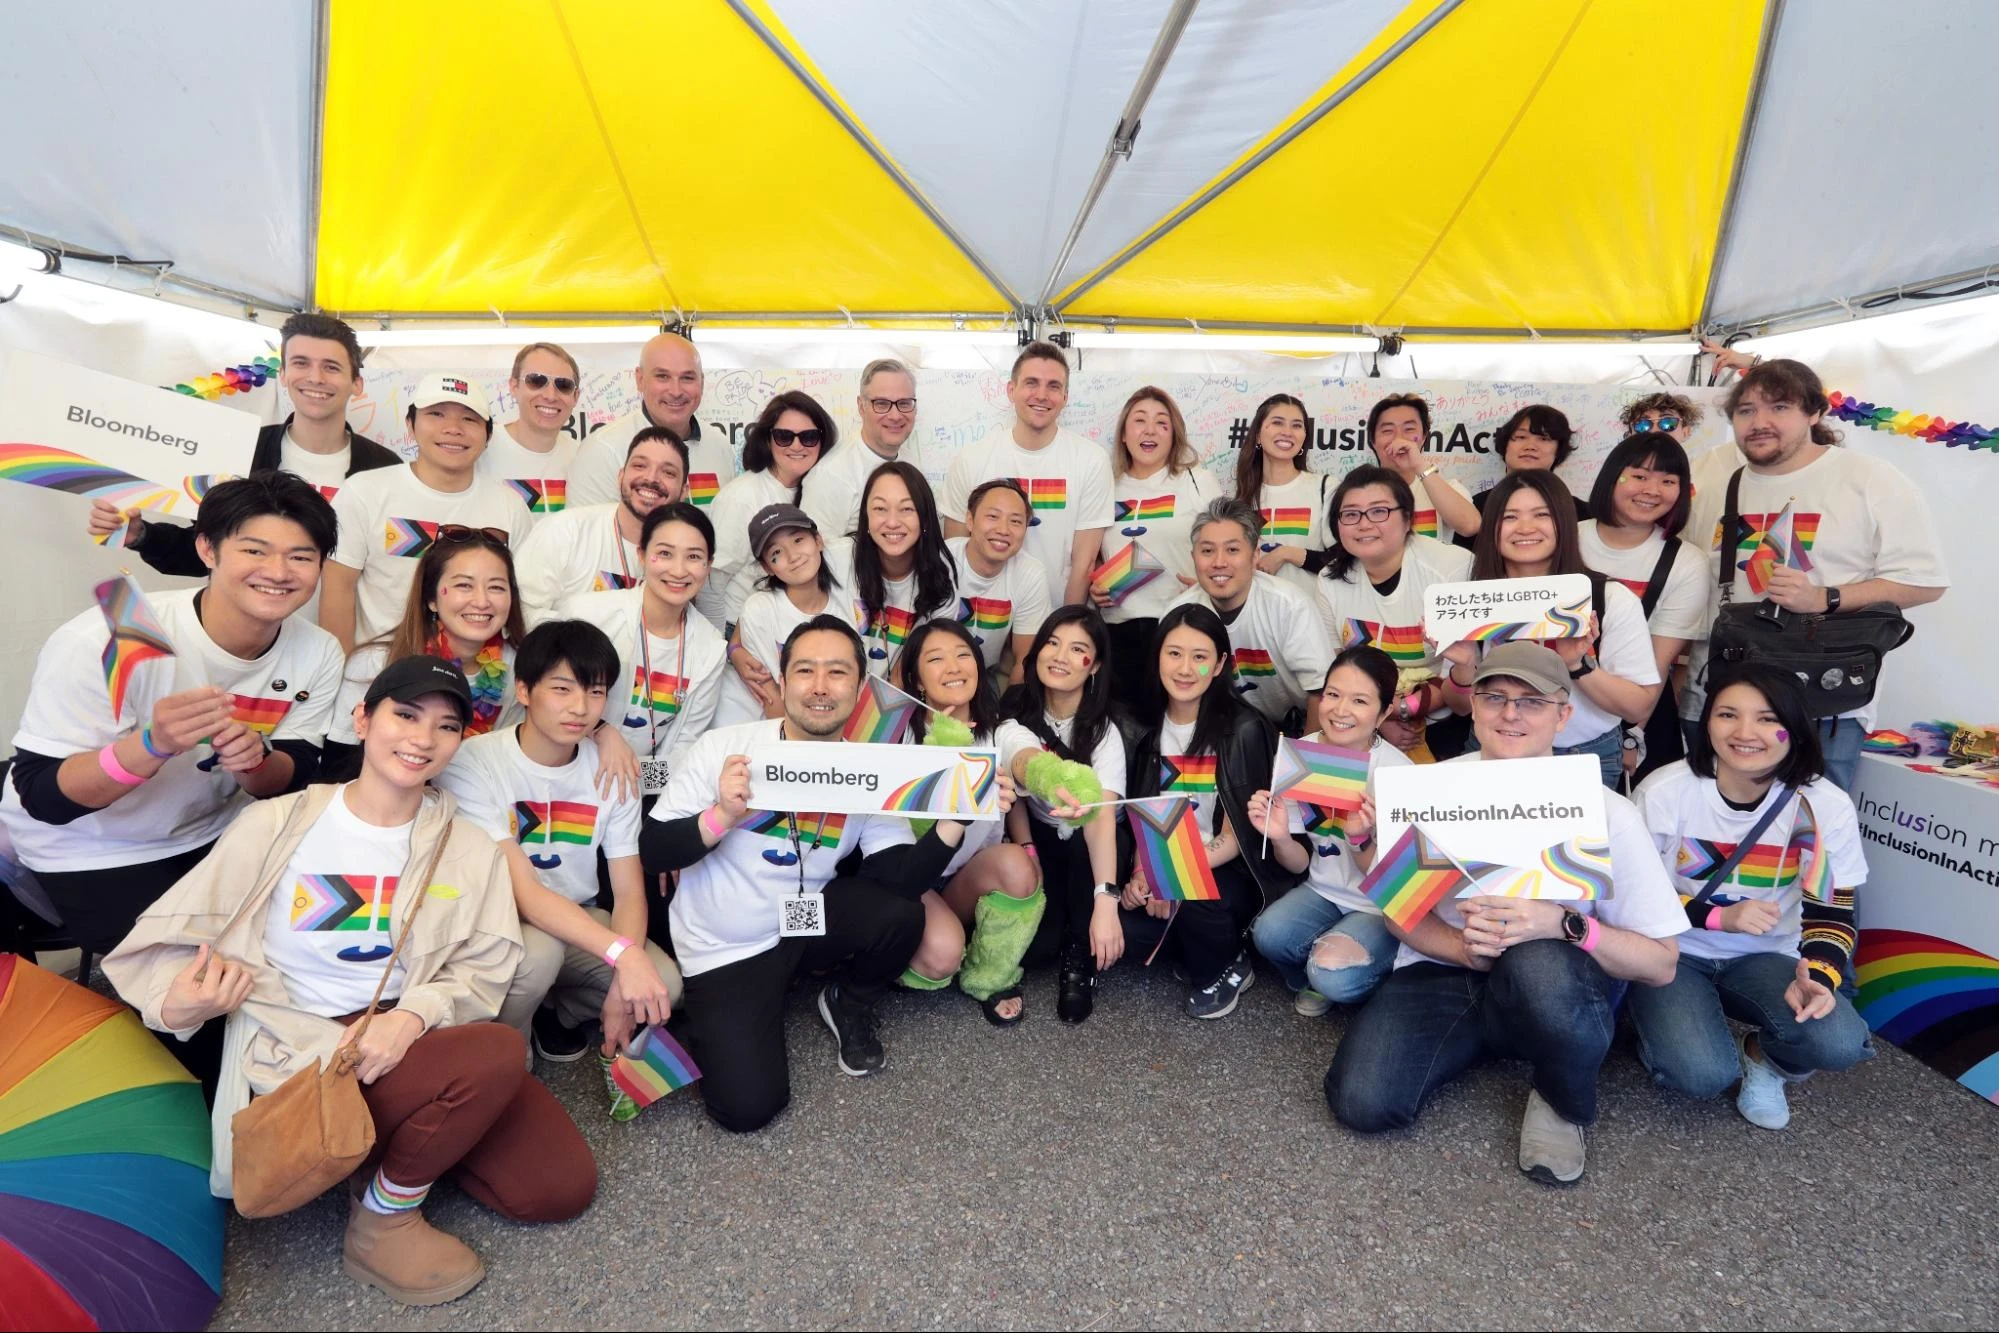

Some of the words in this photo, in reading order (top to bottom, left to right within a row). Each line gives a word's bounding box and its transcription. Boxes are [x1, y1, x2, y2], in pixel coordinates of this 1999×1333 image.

[66, 404, 199, 456] Bloomberg
[1435, 591, 1504, 607] わたしたちは
[1506, 590, 1558, 602] LGBTQ+
[1436, 606, 1493, 620] アライです
[765, 764, 879, 792] Bloomberg
[1390, 802, 1584, 823] #InclusionInAction
[1857, 791, 1968, 848] Inclusion
